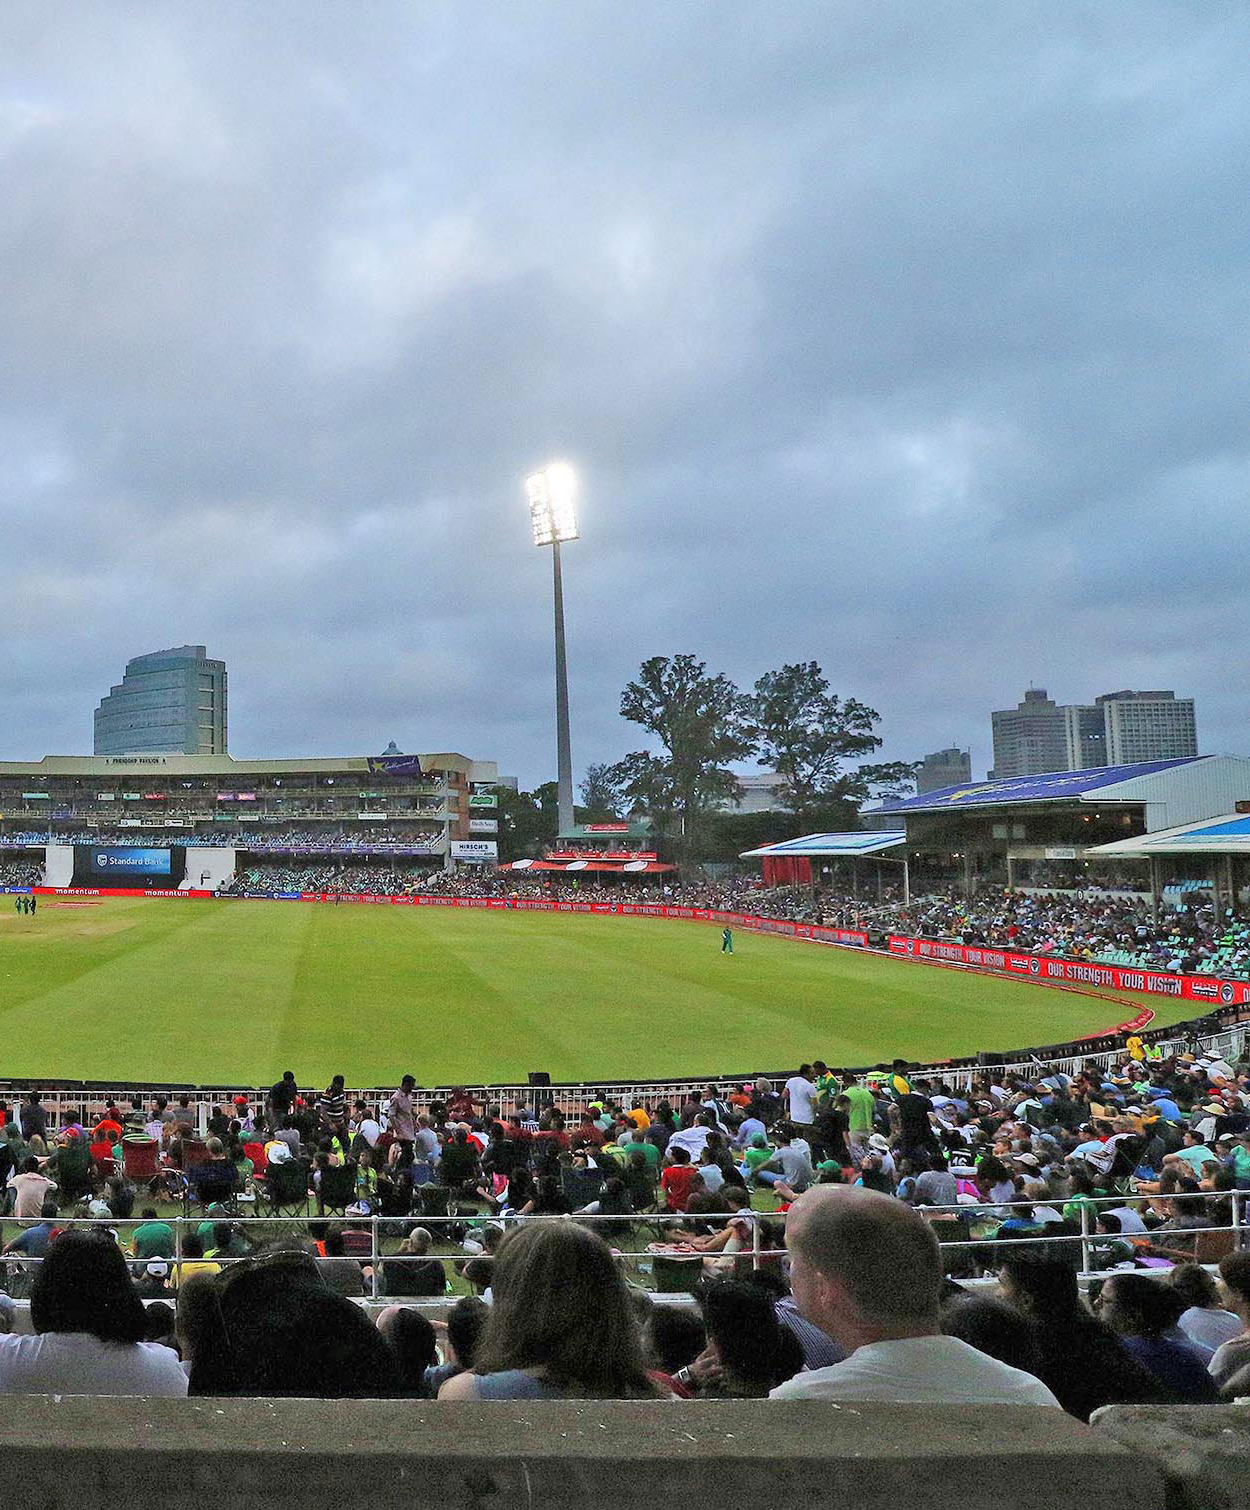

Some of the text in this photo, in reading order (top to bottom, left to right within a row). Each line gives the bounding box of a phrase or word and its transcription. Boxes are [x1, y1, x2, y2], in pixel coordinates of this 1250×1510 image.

[109, 857, 164, 865] Standard Bank
[983, 951, 1006, 966] VISION
[1047, 962, 1065, 977] OUR
[1119, 972, 1144, 990] YOUR
[1147, 976, 1182, 995] VISION
